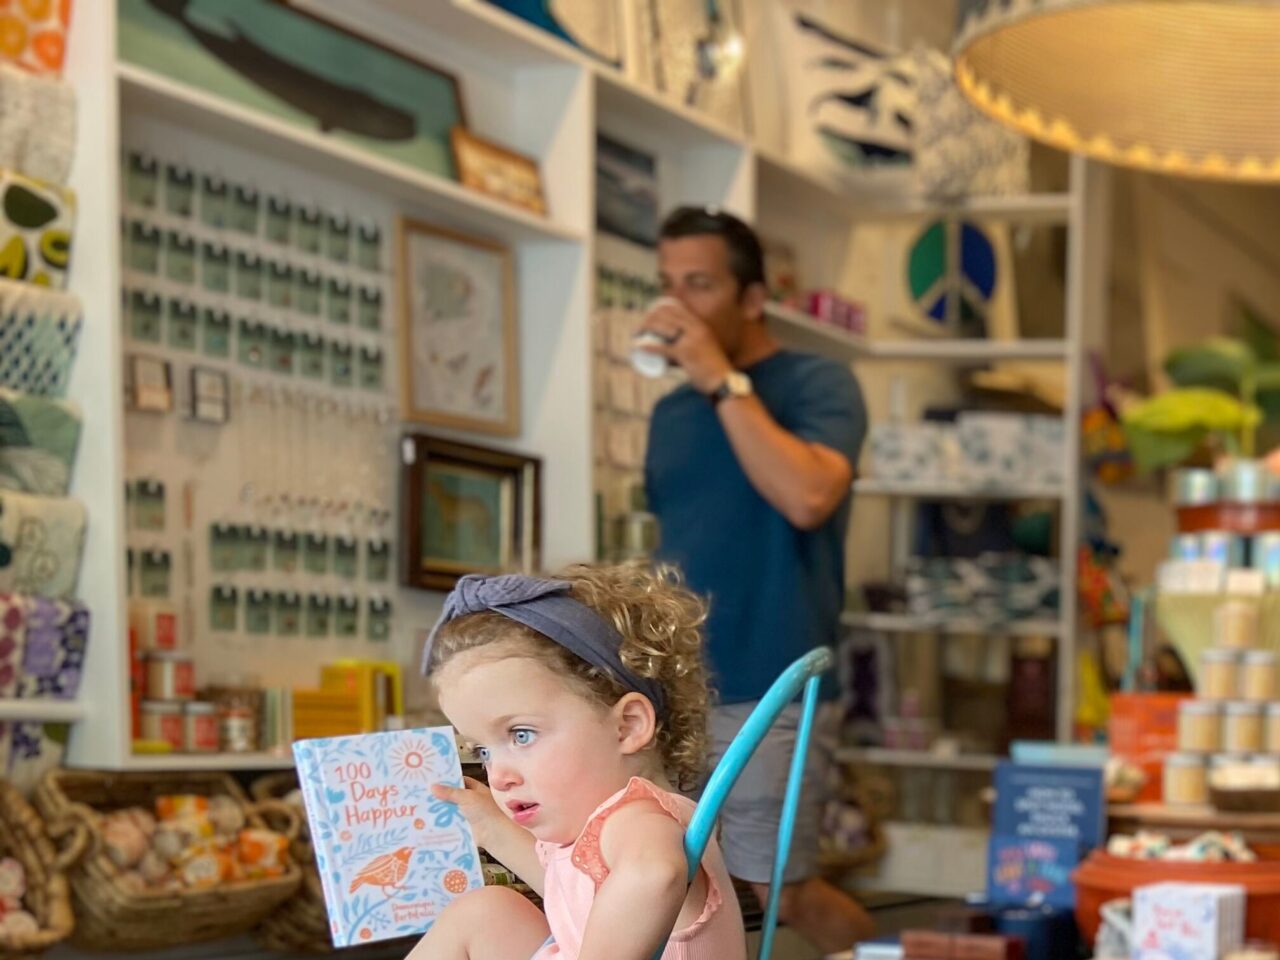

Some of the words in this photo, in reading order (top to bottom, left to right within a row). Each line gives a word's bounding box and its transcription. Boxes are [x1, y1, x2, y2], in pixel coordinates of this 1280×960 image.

[334, 761, 372, 784] 100
[350, 780, 399, 808] Days
[345, 804, 418, 829] Happier
